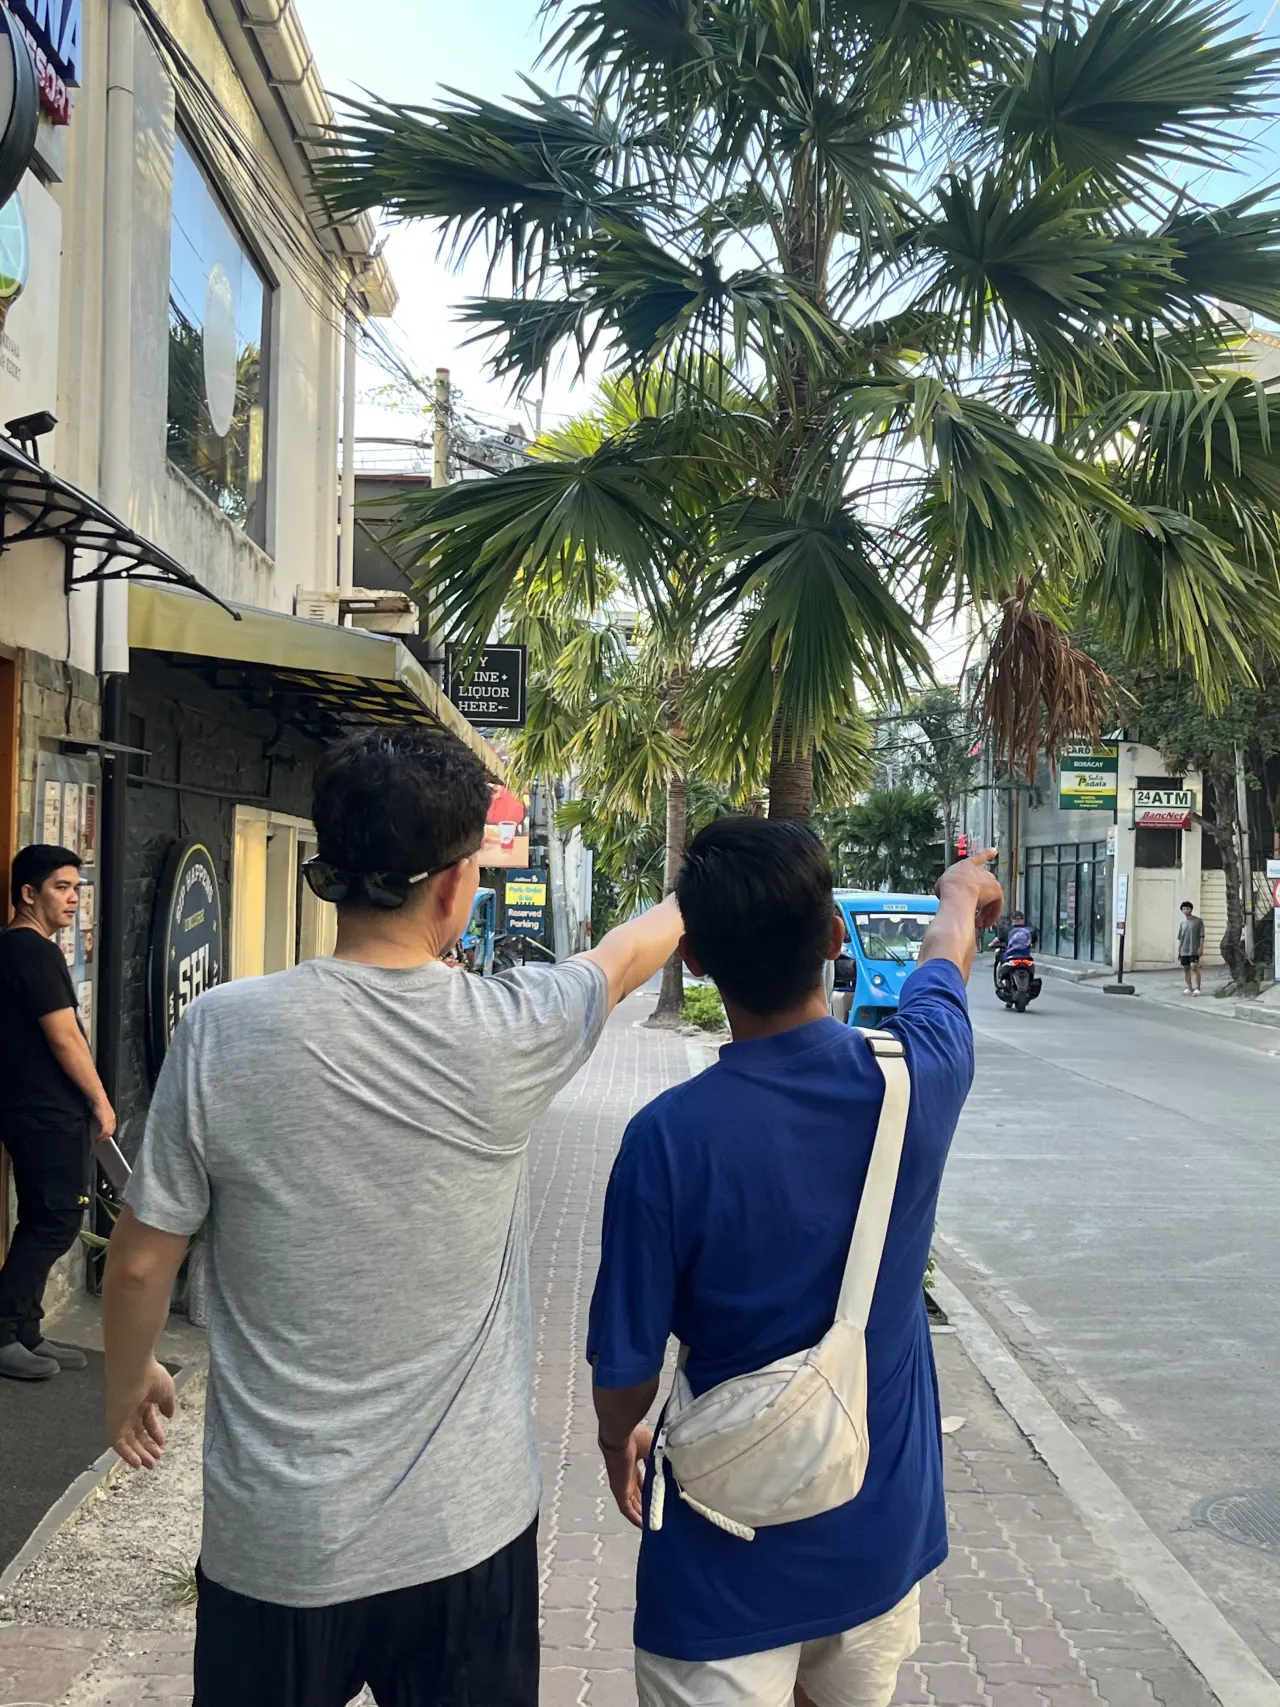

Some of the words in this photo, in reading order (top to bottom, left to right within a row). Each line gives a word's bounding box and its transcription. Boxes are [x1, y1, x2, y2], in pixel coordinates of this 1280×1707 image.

[459, 686, 510, 699] LIQUOR
[458, 701, 498, 712] HERE
[1138, 791, 1150, 801] 24
[1151, 792, 1188, 804] ATM
[1143, 811, 1184, 820] BancNet
[508, 908, 543, 918] Reserved
[510, 919, 540, 930] Parking
